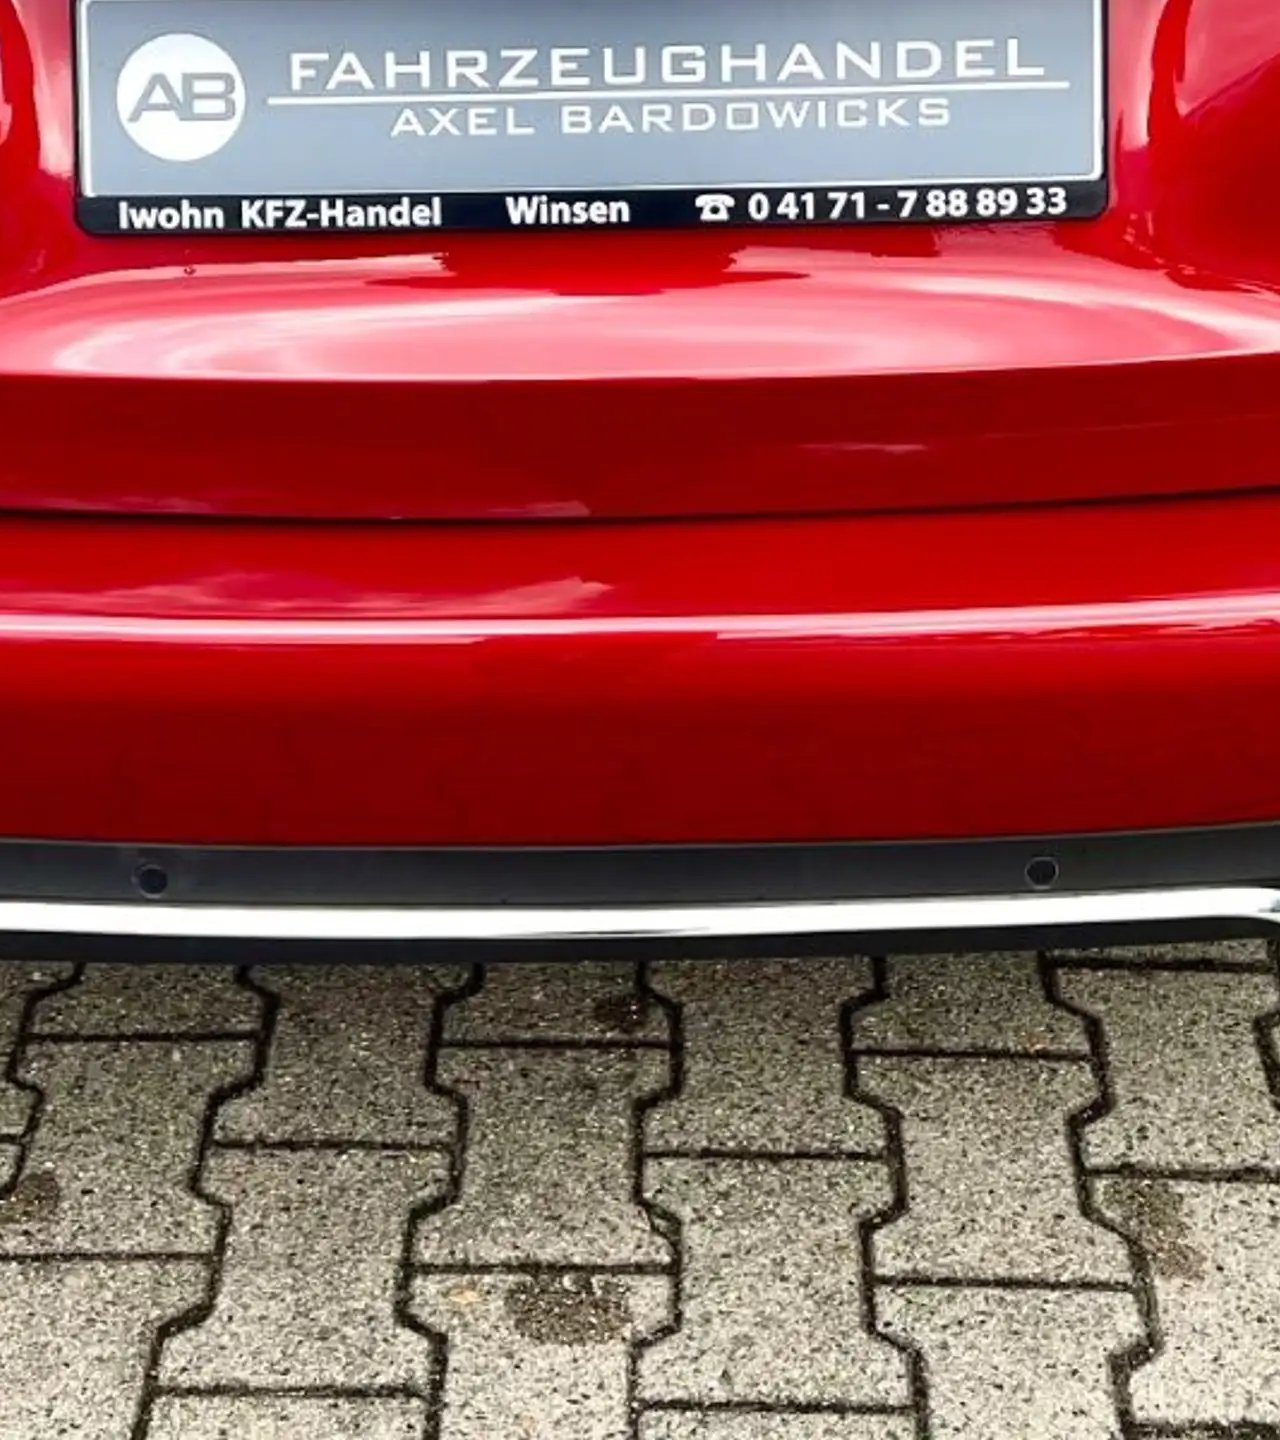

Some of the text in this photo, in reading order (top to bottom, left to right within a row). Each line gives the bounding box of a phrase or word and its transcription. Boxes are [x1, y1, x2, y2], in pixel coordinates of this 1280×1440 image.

[289, 37, 1046, 92] FAHRZEUGHANDEL
[127, 71, 237, 123] AB
[390, 97, 951, 137] AXEL BARDOWICKS
[119, 200, 224, 230] Iwohn
[240, 197, 442, 229] KFZ-Handel
[505, 196, 631, 225] Winsen
